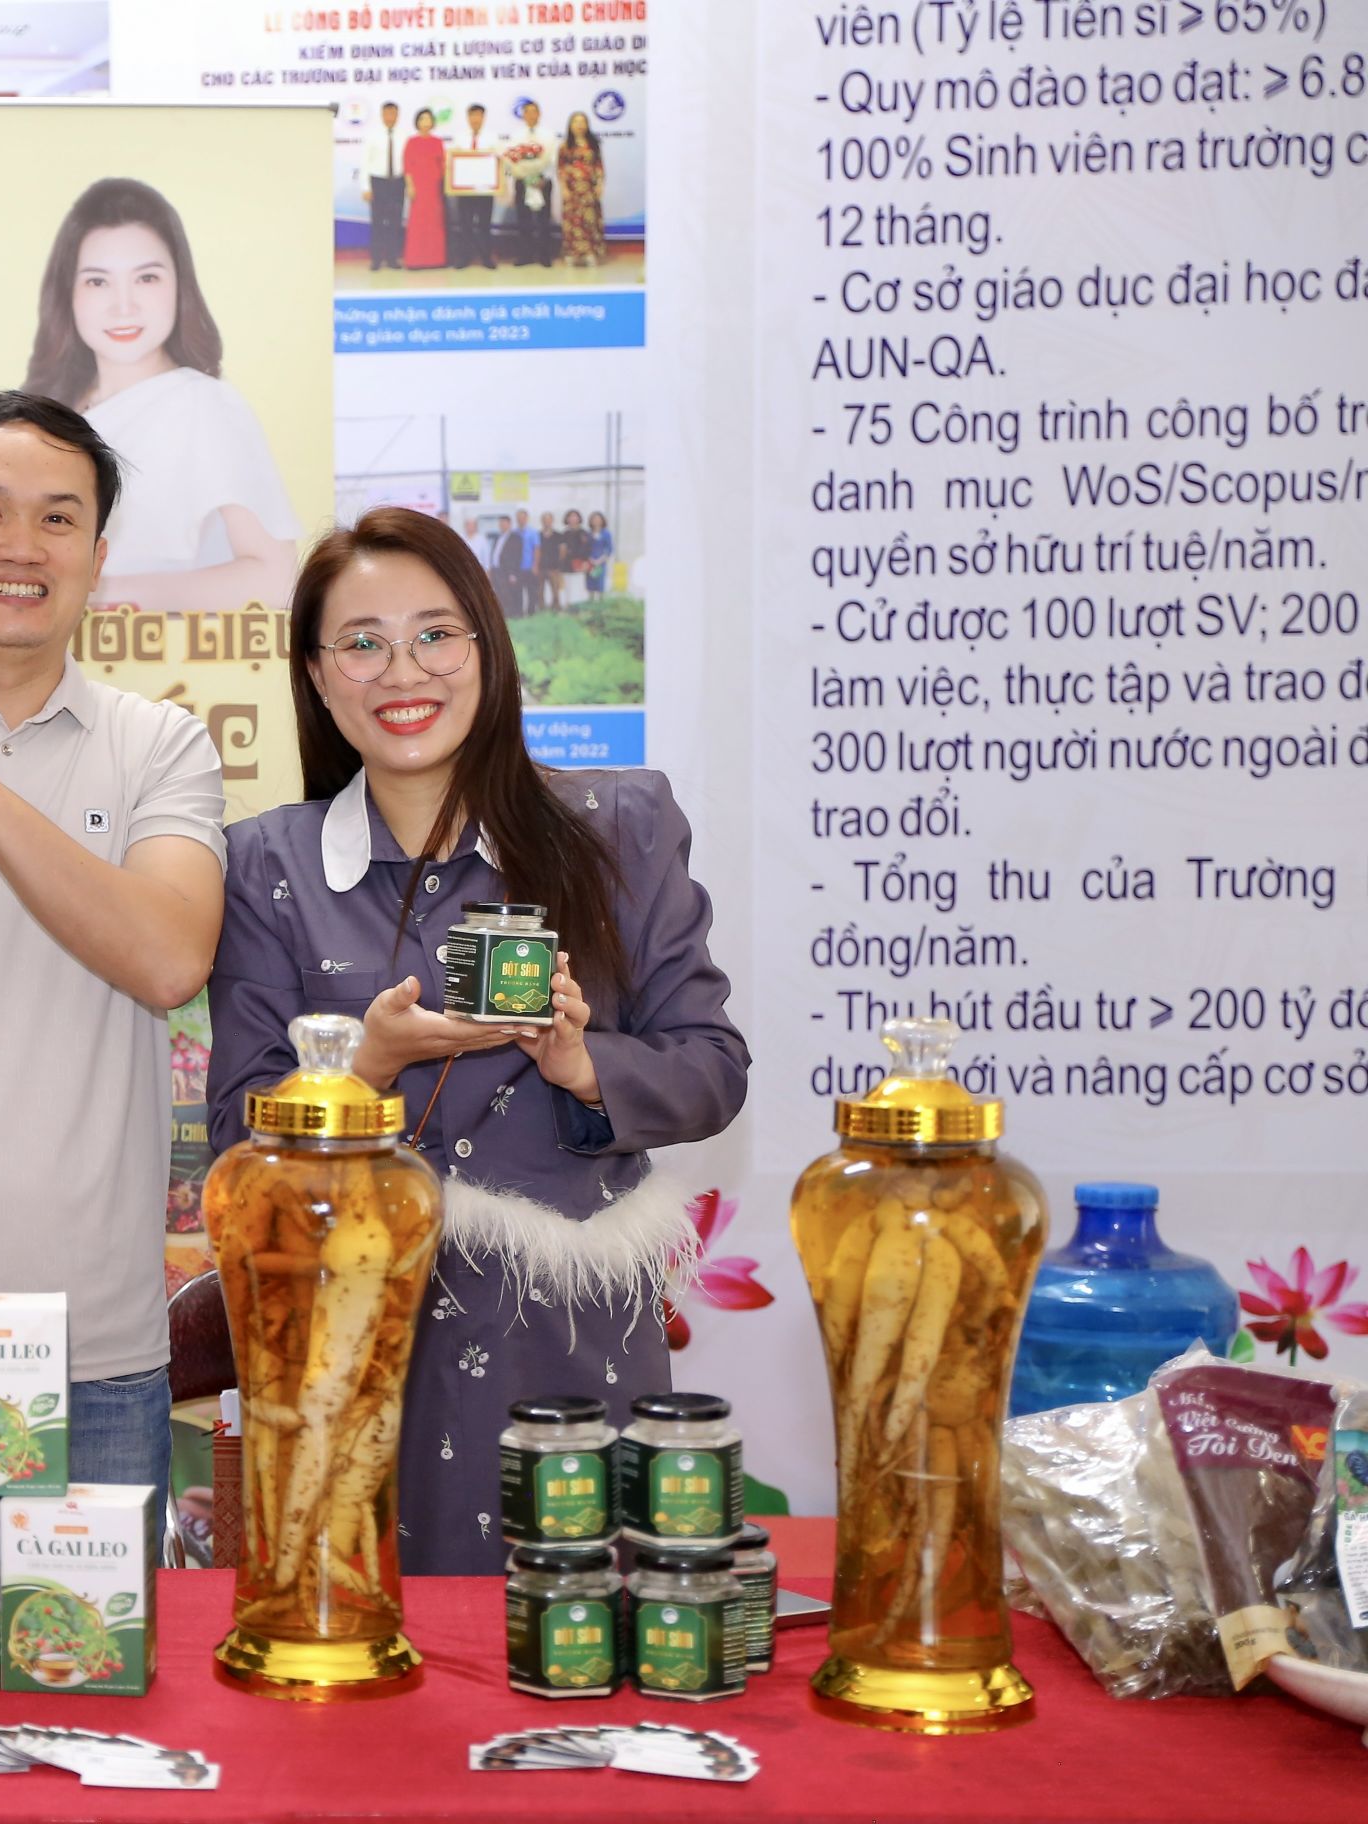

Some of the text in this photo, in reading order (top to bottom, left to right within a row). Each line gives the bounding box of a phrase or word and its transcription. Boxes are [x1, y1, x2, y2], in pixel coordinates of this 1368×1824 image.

[816, 3, 900, 47] viên
[989, 0, 1024, 52] lệ
[839, 69, 926, 124] Quy
[935, 68, 999, 111] mô
[1008, 64, 1087, 109] đào
[1097, 64, 1163, 116] tạo
[1173, 60, 1250, 113] đạt:
[818, 126, 1334, 181] 100% Sinh viên ra trường
[817, 202, 1002, 256] 12 tháng.
[841, 260, 1322, 323] Cơ sở giáo dục đại học
[811, 334, 1006, 381] AUN-QA.
[843, 388, 1321, 455] 75 Công trình công bố
[811, 468, 914, 513] danh
[945, 476, 1033, 520] mục
[811, 528, 1326, 589] quyền sở hữu trí tuệ/năm.
[836, 591, 1359, 652] Cử được 100 lượt SV; 200
[812, 661, 1326, 717] làm việc, thực tập và trao
[812, 724, 1337, 783] 300 lượt người nước ngoài
[90, 814, 102, 825] D
[810, 786, 971, 839] trao đổi.
[853, 852, 1335, 913] Tổng thu của Trường
[810, 922, 1028, 979] đồng/năm.
[1005, 983, 1081, 1032] đầu
[1096, 991, 1138, 1031] tư
[1188, 987, 1266, 1030] 200
[1280, 985, 1317, 1041] tỷ
[948, 1054, 996, 1095] ới
[1007, 1055, 1054, 1096] và
[1066, 1055, 1167, 1107] nâng
[1178, 1046, 1254, 1106] cấp
[1264, 1060, 1315, 1096] cơ
[11, 1343, 51, 1360] LEO
[17, 1535, 128, 1559] CÀ GAI LEO
